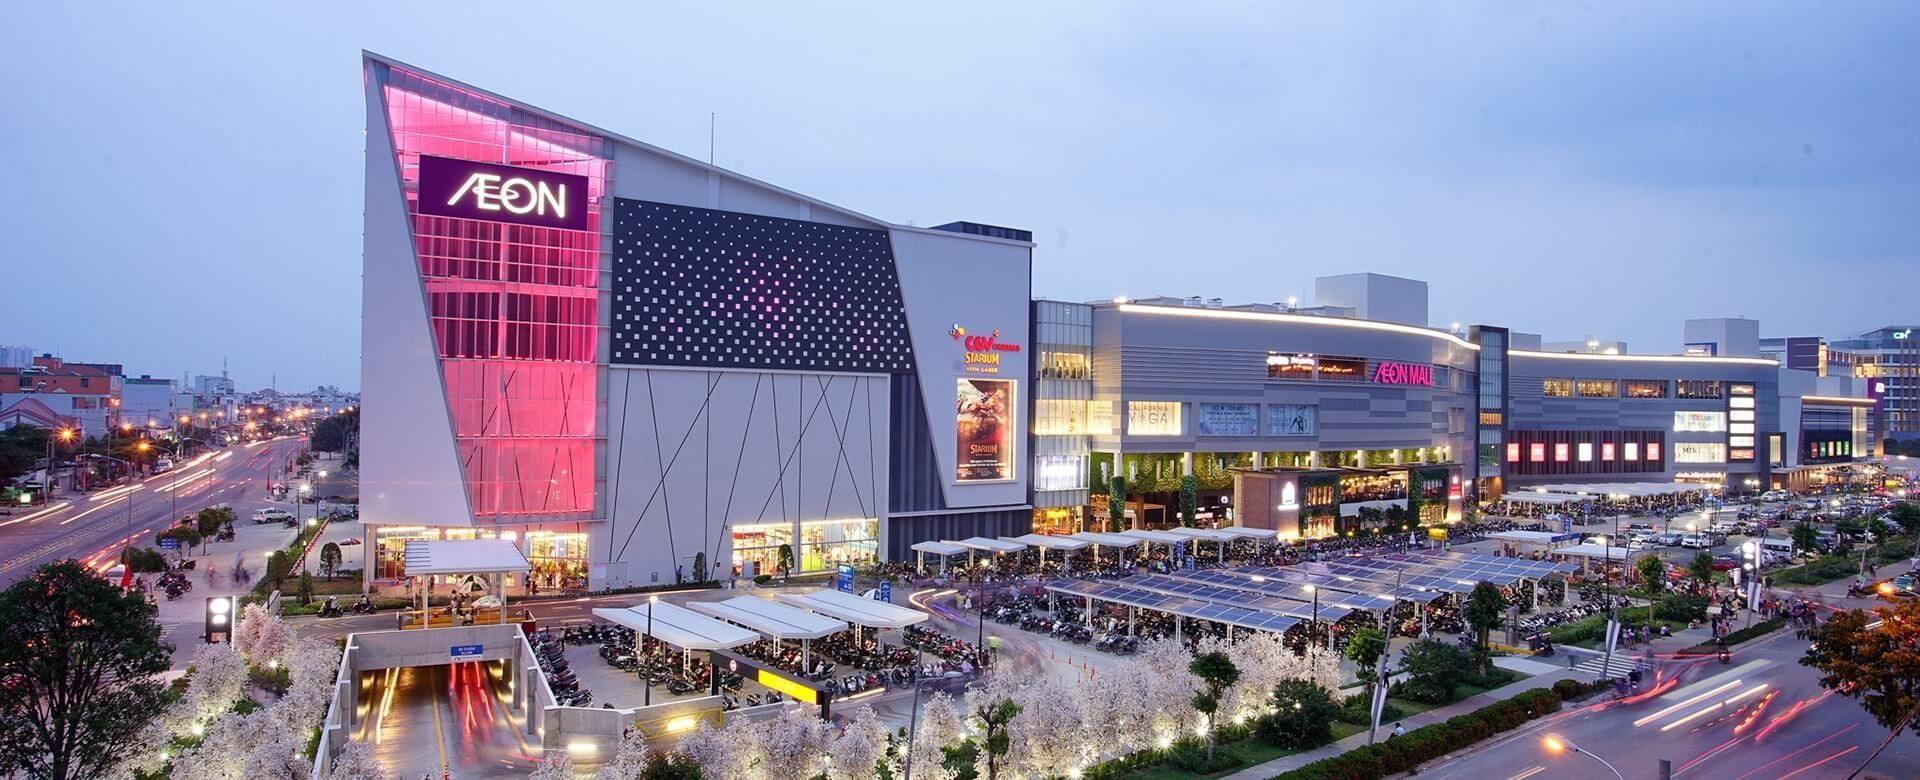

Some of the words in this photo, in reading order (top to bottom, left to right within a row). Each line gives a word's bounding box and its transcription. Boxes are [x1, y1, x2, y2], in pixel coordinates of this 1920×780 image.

[965, 352, 999, 365] STARIUM
[1409, 364, 1435, 385] MALL
[970, 443, 998, 454] STARIUM
